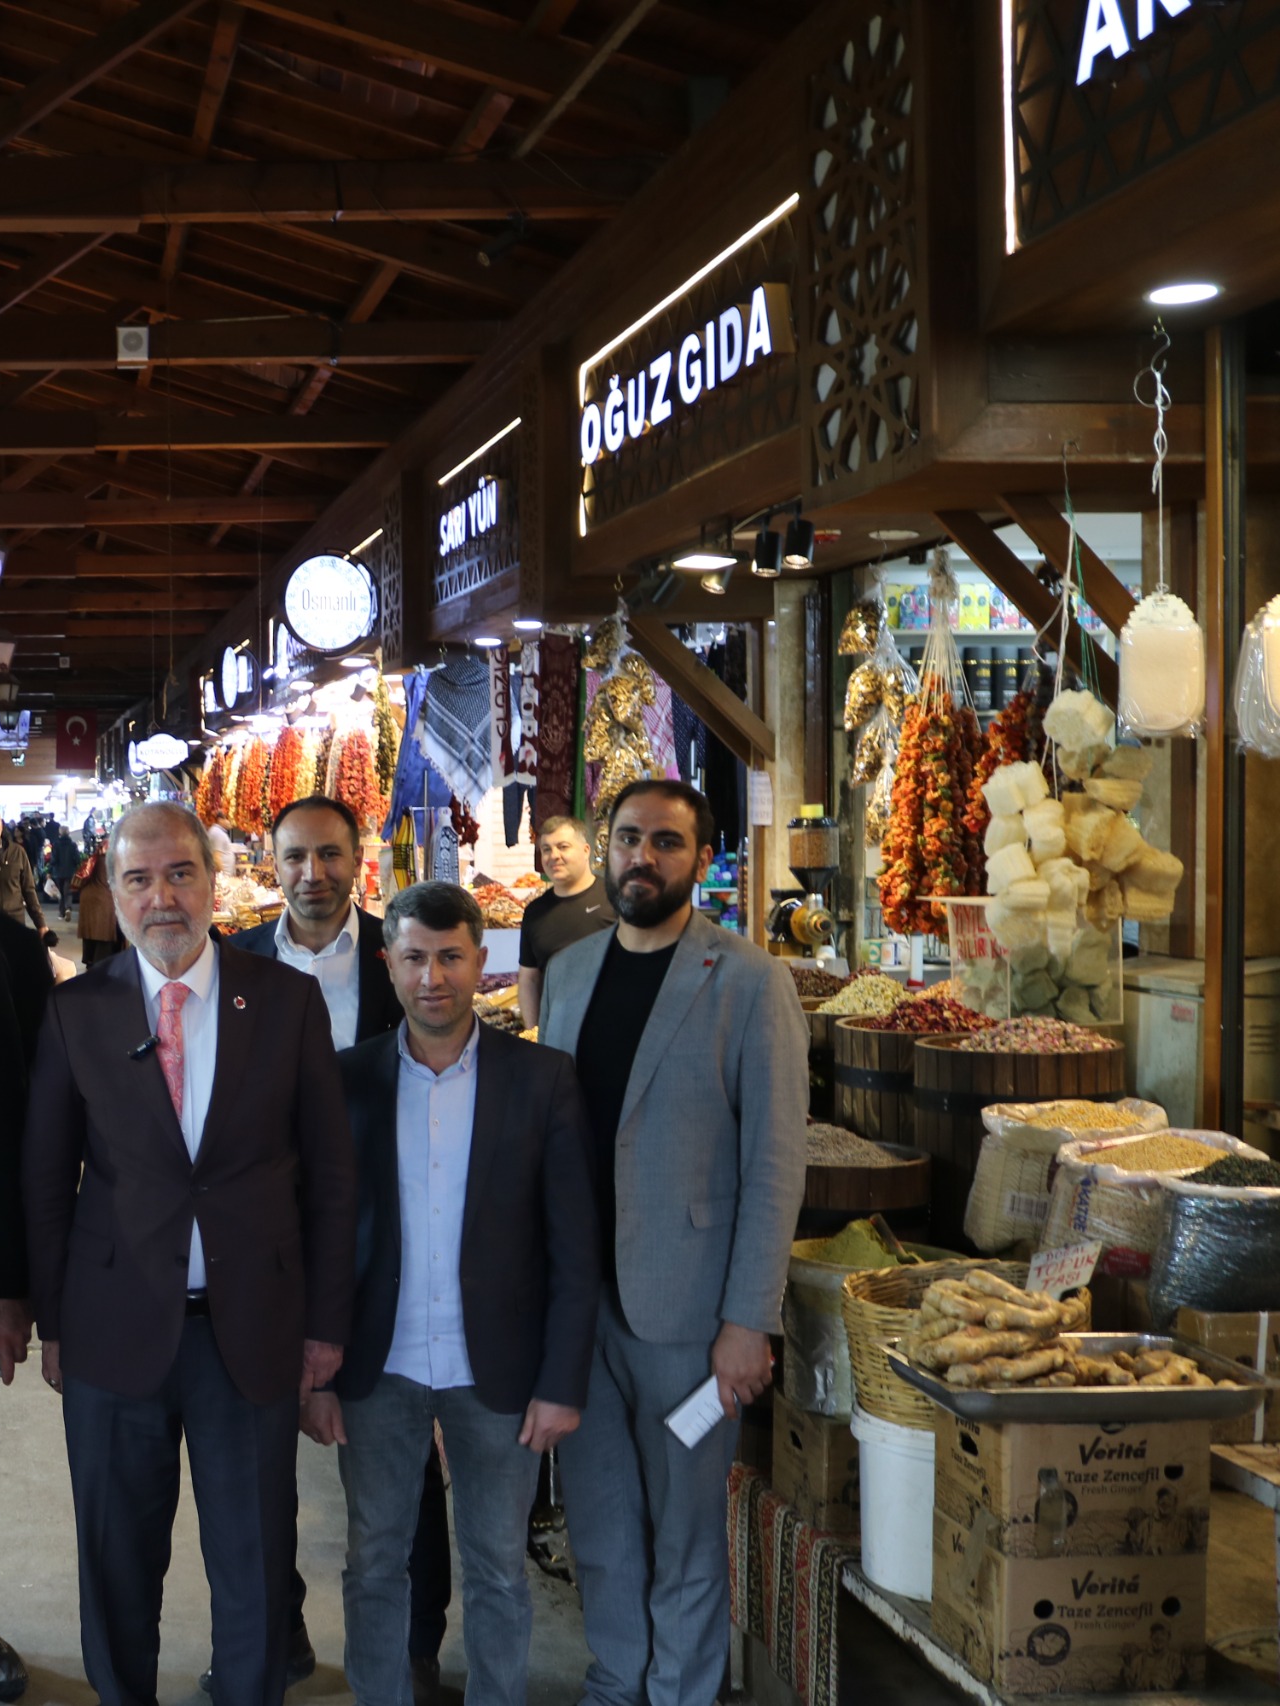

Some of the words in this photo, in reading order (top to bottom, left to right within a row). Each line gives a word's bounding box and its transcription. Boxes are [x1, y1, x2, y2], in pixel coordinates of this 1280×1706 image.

[580, 348, 674, 465] OĞUZ
[678, 285, 773, 406] GIDA
[439, 500, 466, 557] SARI
[468, 476, 498, 537] YÜN
[301, 588, 357, 612] Osmanlı
[1073, 1186, 1092, 1233] KATRE
[1064, 1470, 1099, 1484] Taze
[1103, 1466, 1160, 1485] Zencefil
[1080, 1485, 1107, 1496] Fresh
[1110, 1484, 1142, 1498] Ginger
[1057, 1604, 1092, 1619] Taze
[1096, 1602, 1153, 1620] Zencefil
[1074, 1620, 1100, 1631] Fresh
[1103, 1619, 1136, 1632] Ginger
